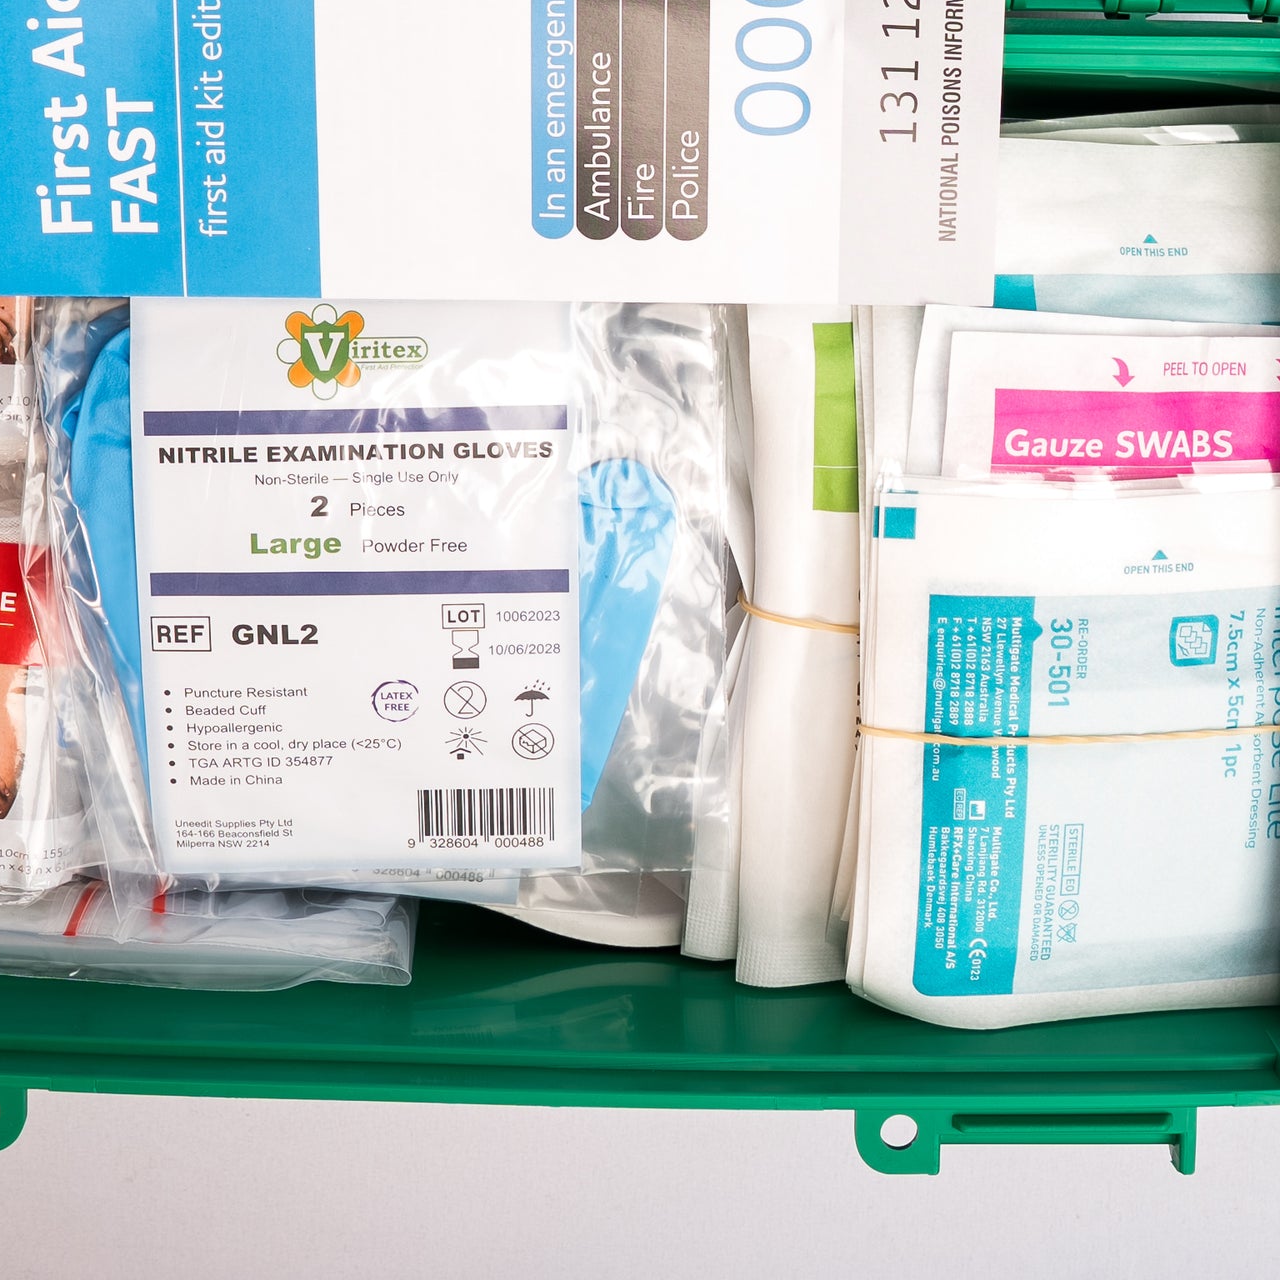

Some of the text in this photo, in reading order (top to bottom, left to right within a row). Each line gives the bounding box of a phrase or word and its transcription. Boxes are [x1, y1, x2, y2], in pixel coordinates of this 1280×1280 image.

[193, 70, 223, 108] kit
[879, 60, 918, 142] 131
[941, 67, 961, 145] POISONS
[195, 121, 225, 164] aid
[583, 52, 611, 221] Ambulance
[36, 94, 92, 233] First
[106, 87, 158, 232] FAST
[547, 149, 565, 182] an
[670, 130, 699, 220] Police
[624, 163, 654, 220] Fire
[938, 153, 958, 242] NATIONAL
[198, 173, 227, 237] first
[539, 194, 565, 217] In
[304, 332, 423, 372] Viritex
[1163, 361, 1246, 376] PEEL TO OPEN
[159, 442, 552, 463] NITRILE EXAMINATION GLOVES
[1005, 427, 1236, 461] Gauze SWABS
[255, 473, 328, 485] Non-Sterile
[352, 472, 393, 485] Single
[398, 471, 423, 482] Use
[428, 470, 458, 484] Only
[310, 495, 404, 517] 2 Pieces
[250, 533, 467, 559] Large Powder Free
[1123, 562, 1193, 574] OPEN THIS END
[447, 609, 480, 622] LOT
[496, 610, 560, 621] 10062023
[157, 625, 204, 643] REF
[232, 624, 318, 645] GNL2
[1226, 610, 1244, 671] 7.5cm
[489, 643, 560, 655] 10/06/2028
[1076, 618, 1088, 679] RE-ORDER
[1048, 618, 1073, 705] 30-501
[184, 687, 307, 698] Puncture Resistant
[1227, 677, 1239, 688] x
[380, 691, 412, 699] LATEX
[185, 705, 266, 715] Beaded Cuff
[384, 703, 409, 711] FREE
[187, 723, 282, 735] Hypoallergenic
[188, 755, 332, 768] TGA ARTG ID 354877
[1221, 744, 1241, 777] 1pc
[190, 775, 225, 785] Made
[245, 774, 282, 784] China
[426, 835, 478, 848] 328604
[492, 834, 543, 848] 000488
